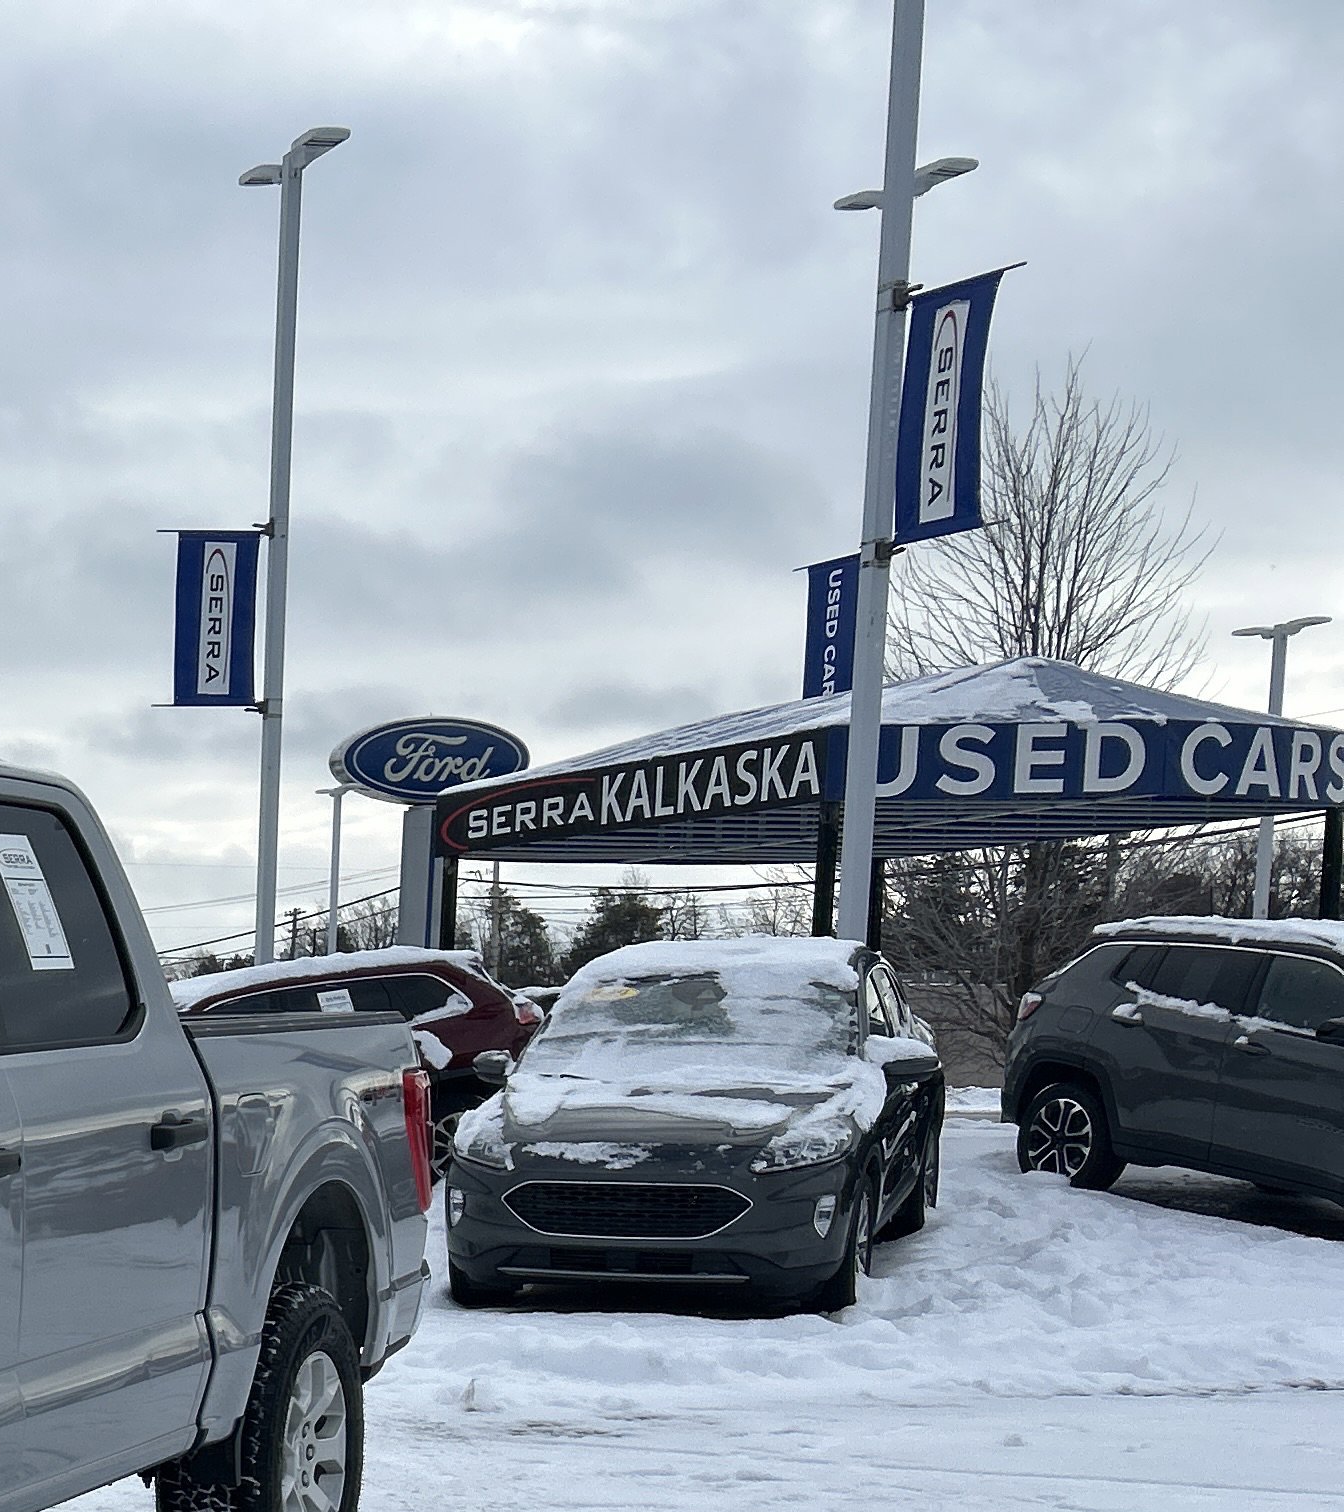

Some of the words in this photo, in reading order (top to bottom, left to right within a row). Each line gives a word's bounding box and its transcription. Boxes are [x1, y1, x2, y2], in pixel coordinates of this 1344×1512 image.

[927, 346, 954, 507] SERRA
[205, 573, 224, 684] SERRA
[825, 568, 843, 638] USED
[383, 732, 495, 783] Ford
[467, 792, 594, 839] SERRA
[600, 741, 820, 825] KALKASKA
[876, 723, 1146, 797] USED
[3, 853, 33, 865] SERRA
